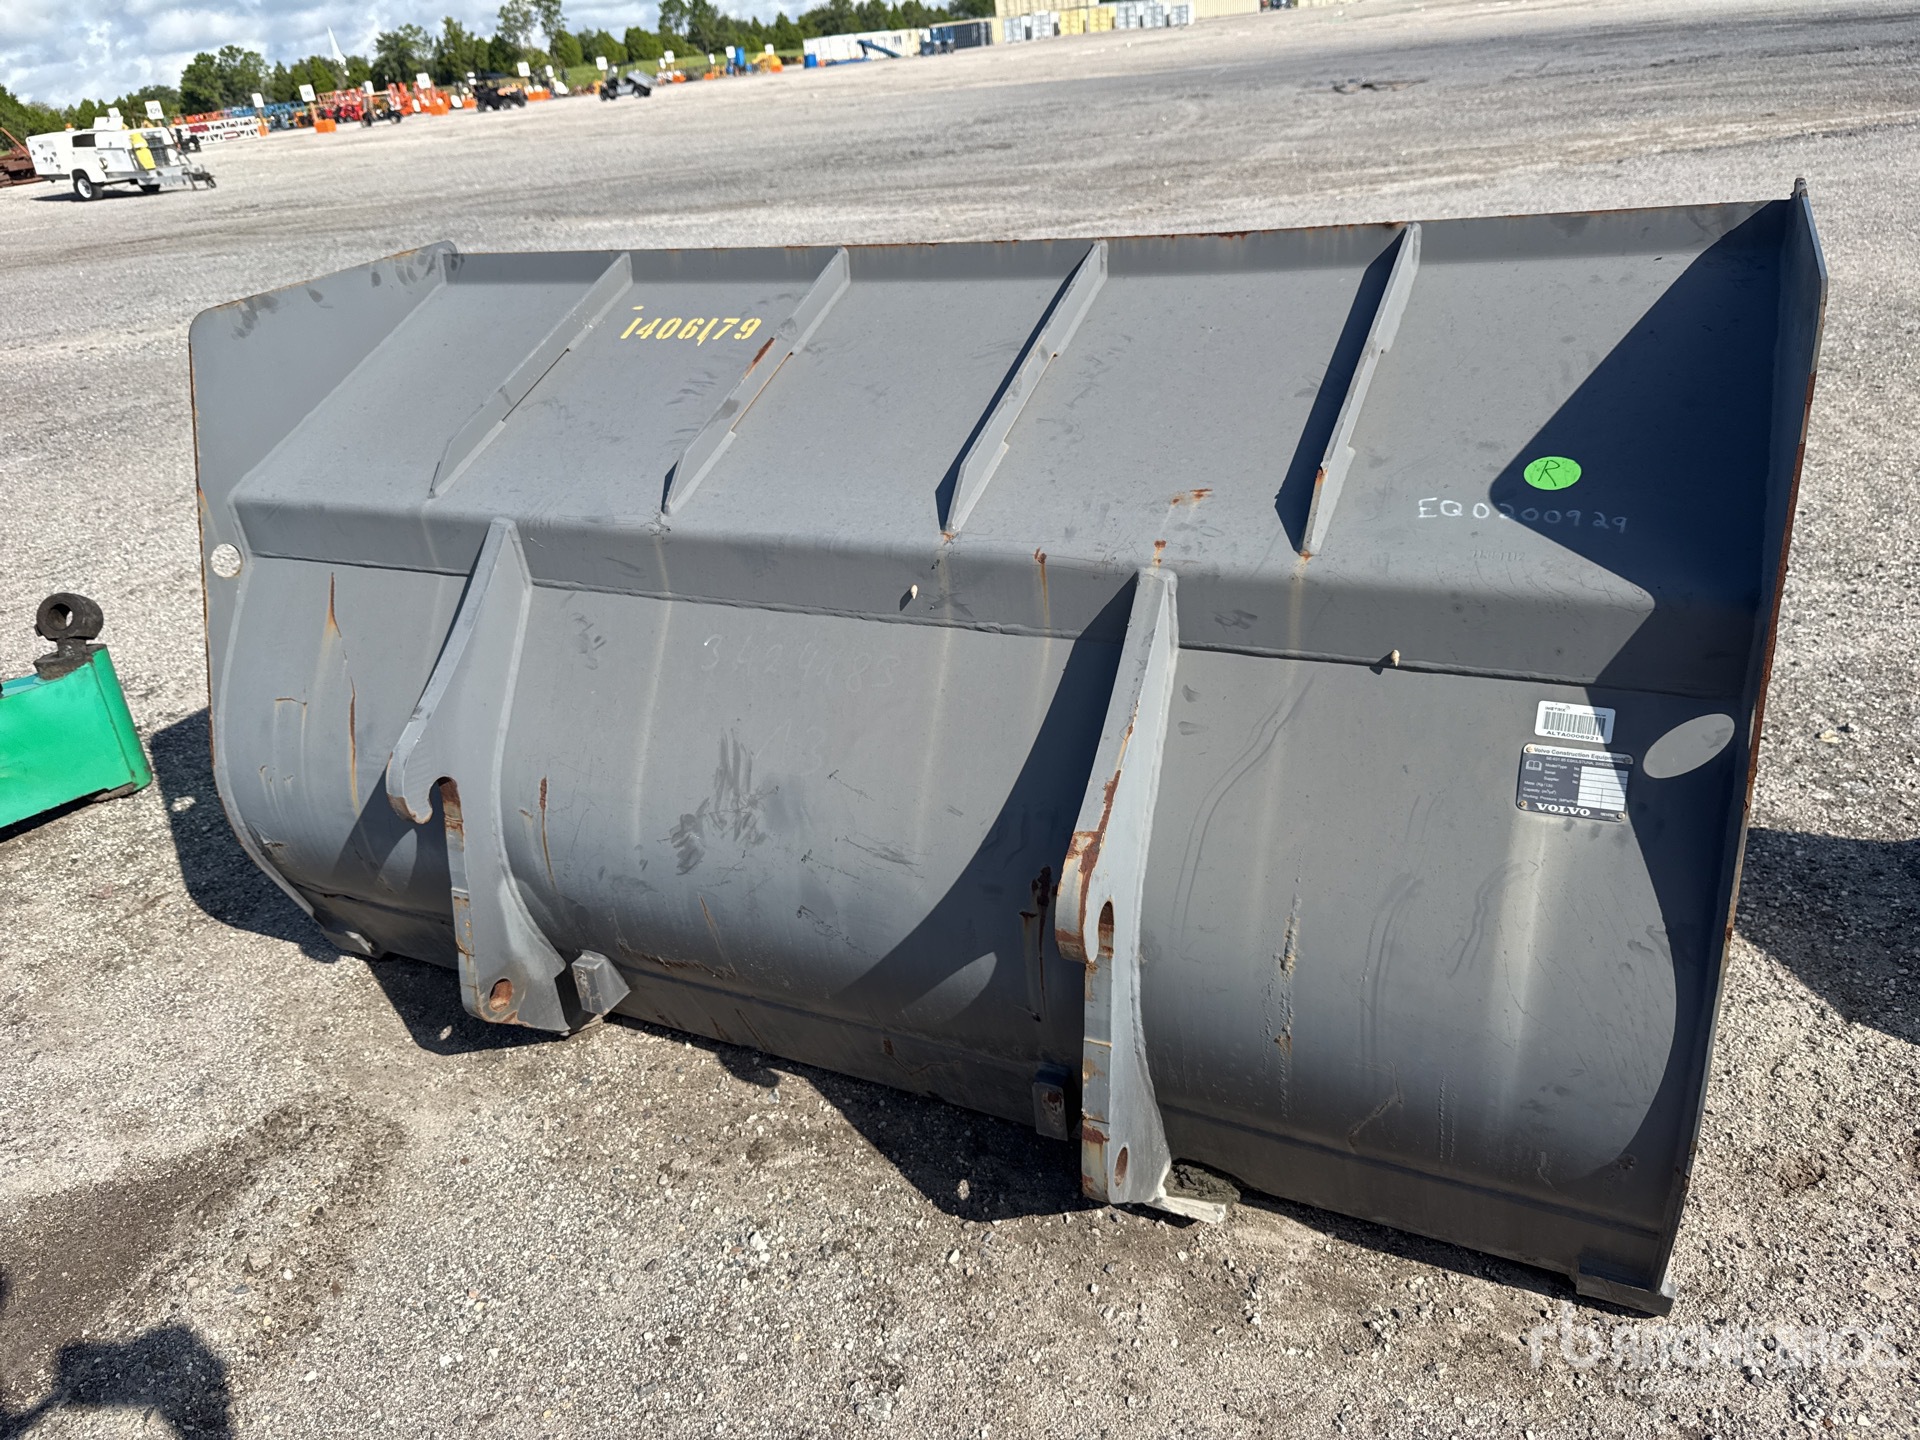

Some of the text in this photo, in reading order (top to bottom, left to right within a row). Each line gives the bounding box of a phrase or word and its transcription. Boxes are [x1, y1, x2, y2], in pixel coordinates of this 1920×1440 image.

[620, 317, 762, 345] 1406179
[1538, 460, 1561, 487] R
[1546, 730, 1599, 742] ALTA0006921
[1534, 747, 1550, 755] Volvo
[1551, 748, 1590, 759] Construction
[1535, 802, 1591, 816] VOLVO
